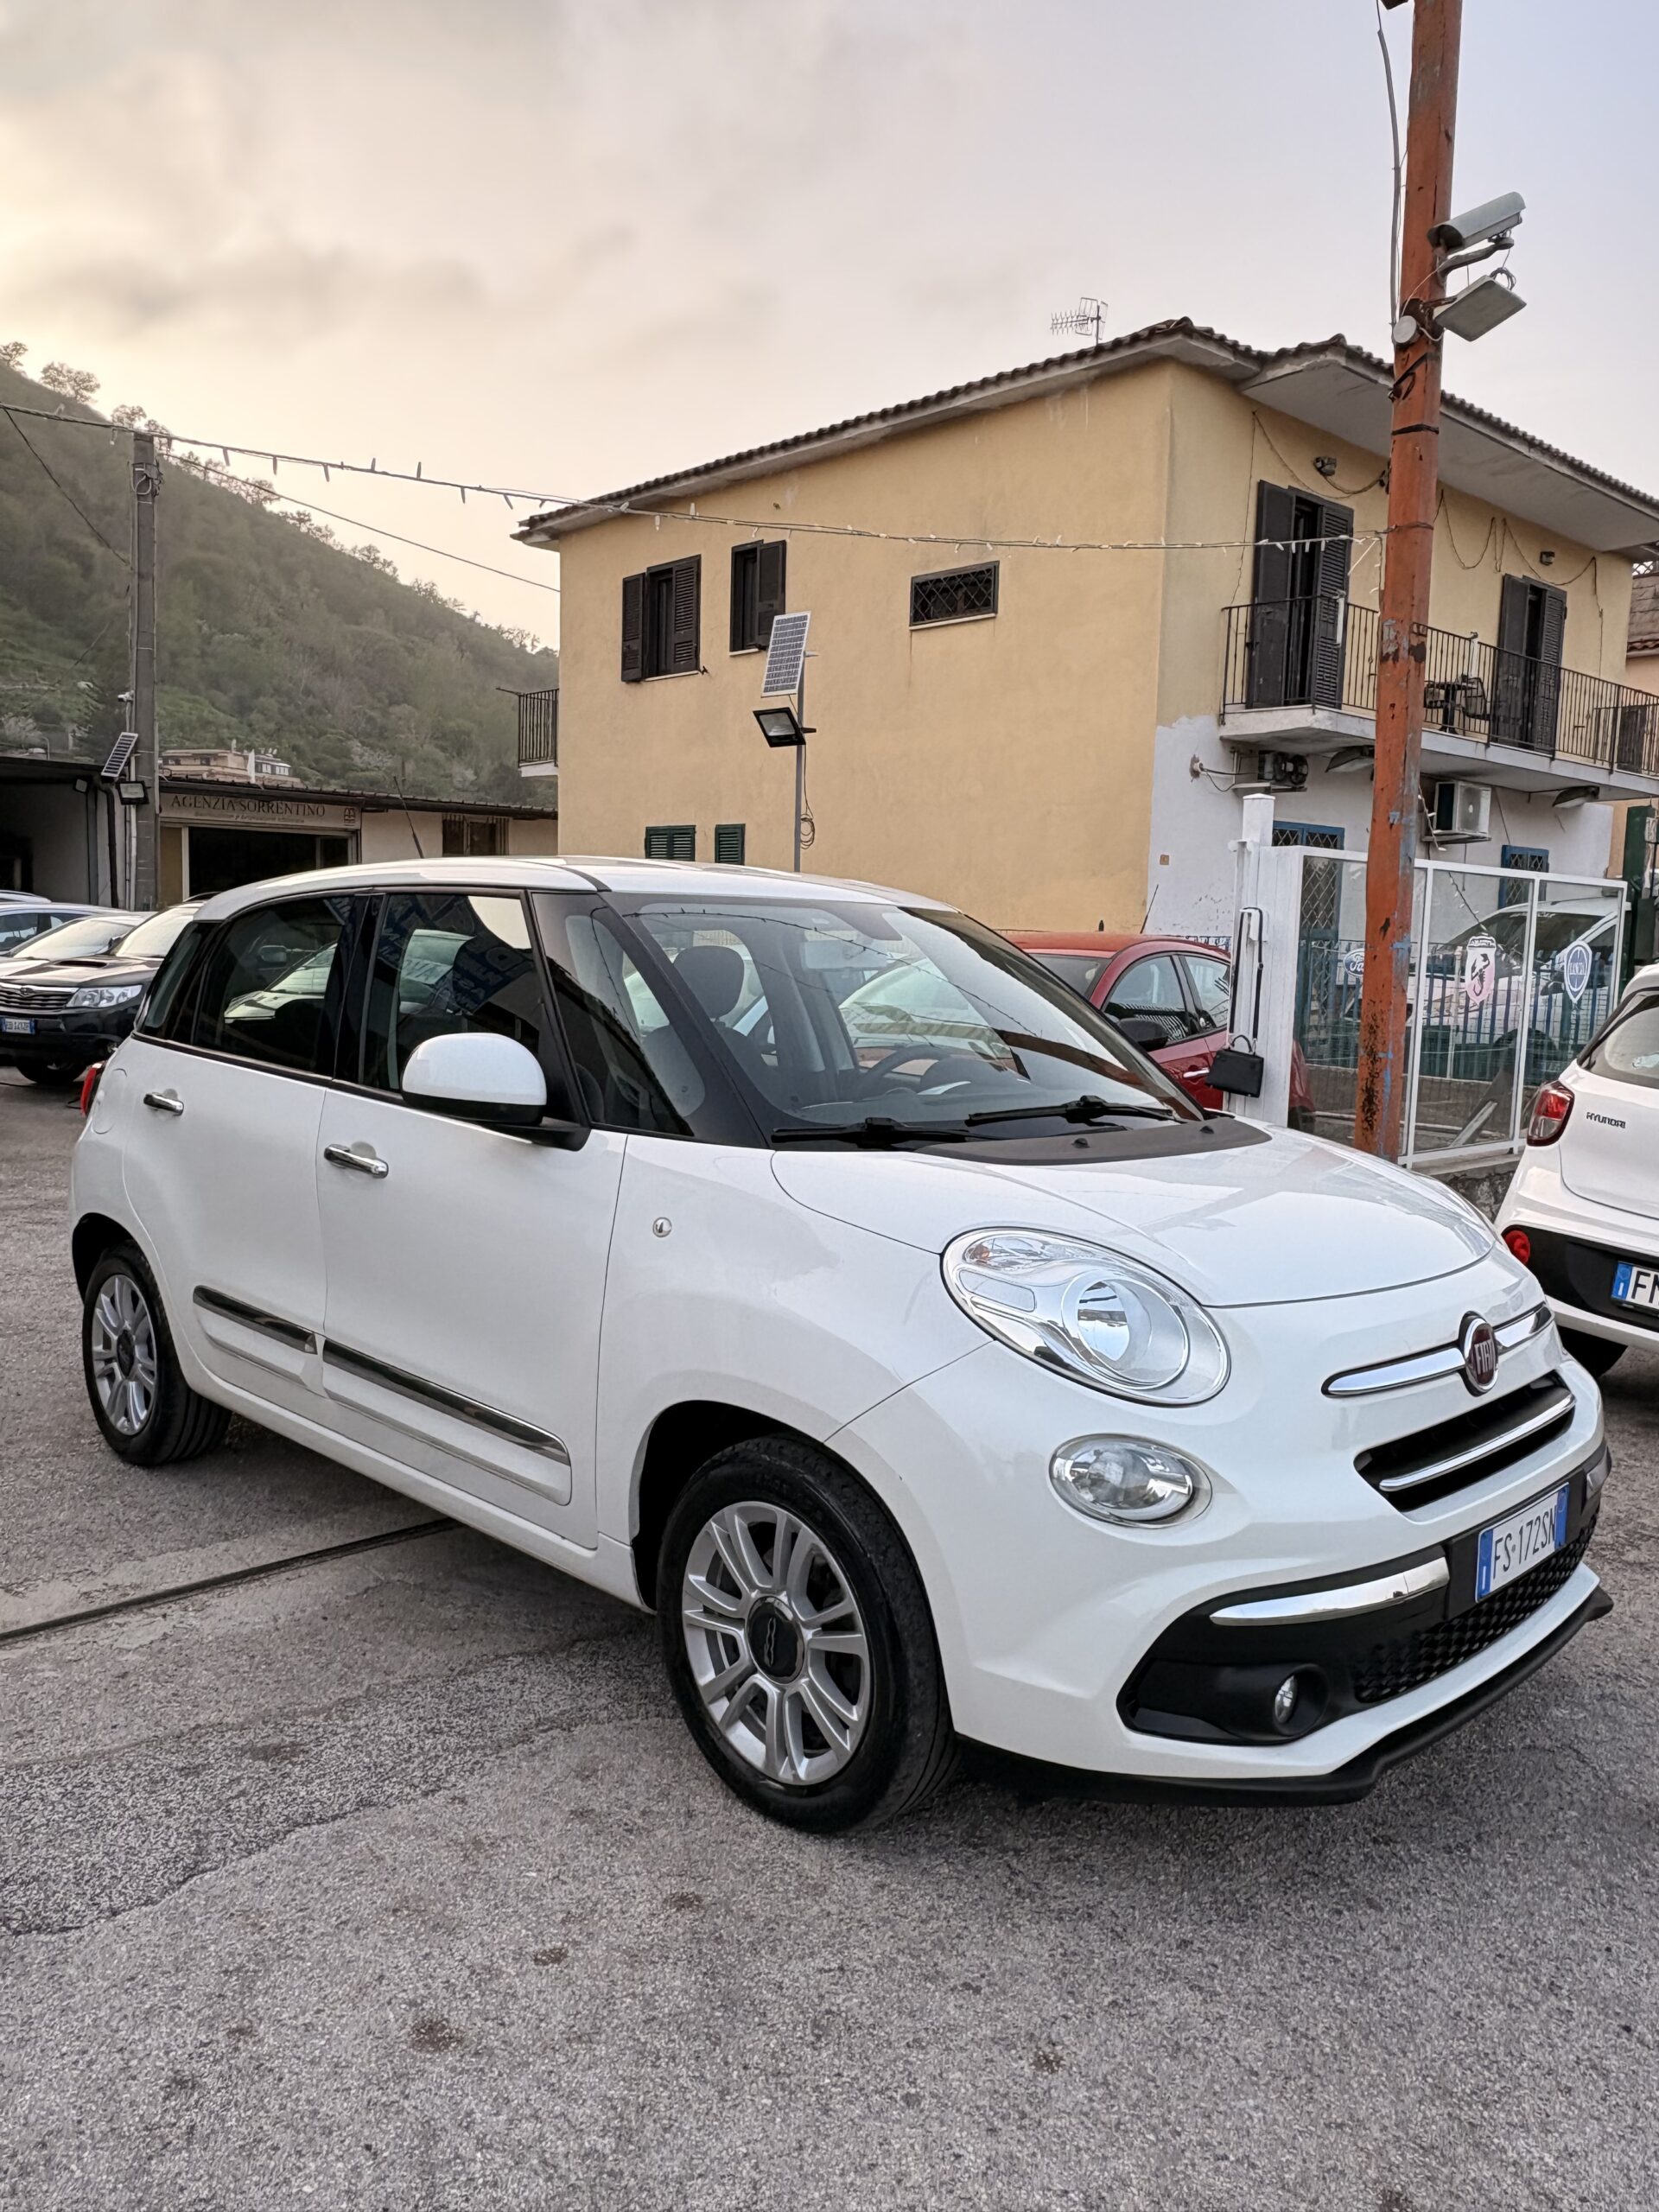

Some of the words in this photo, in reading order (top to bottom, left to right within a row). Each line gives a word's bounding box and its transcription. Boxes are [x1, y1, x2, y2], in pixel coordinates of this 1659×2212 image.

[171, 794, 236, 811] AGENZIA
[238, 799, 326, 817] SORRENTINO
[1586, 1111, 1626, 1129] HYUNDAI
[1473, 1339, 1496, 1376] FIAT
